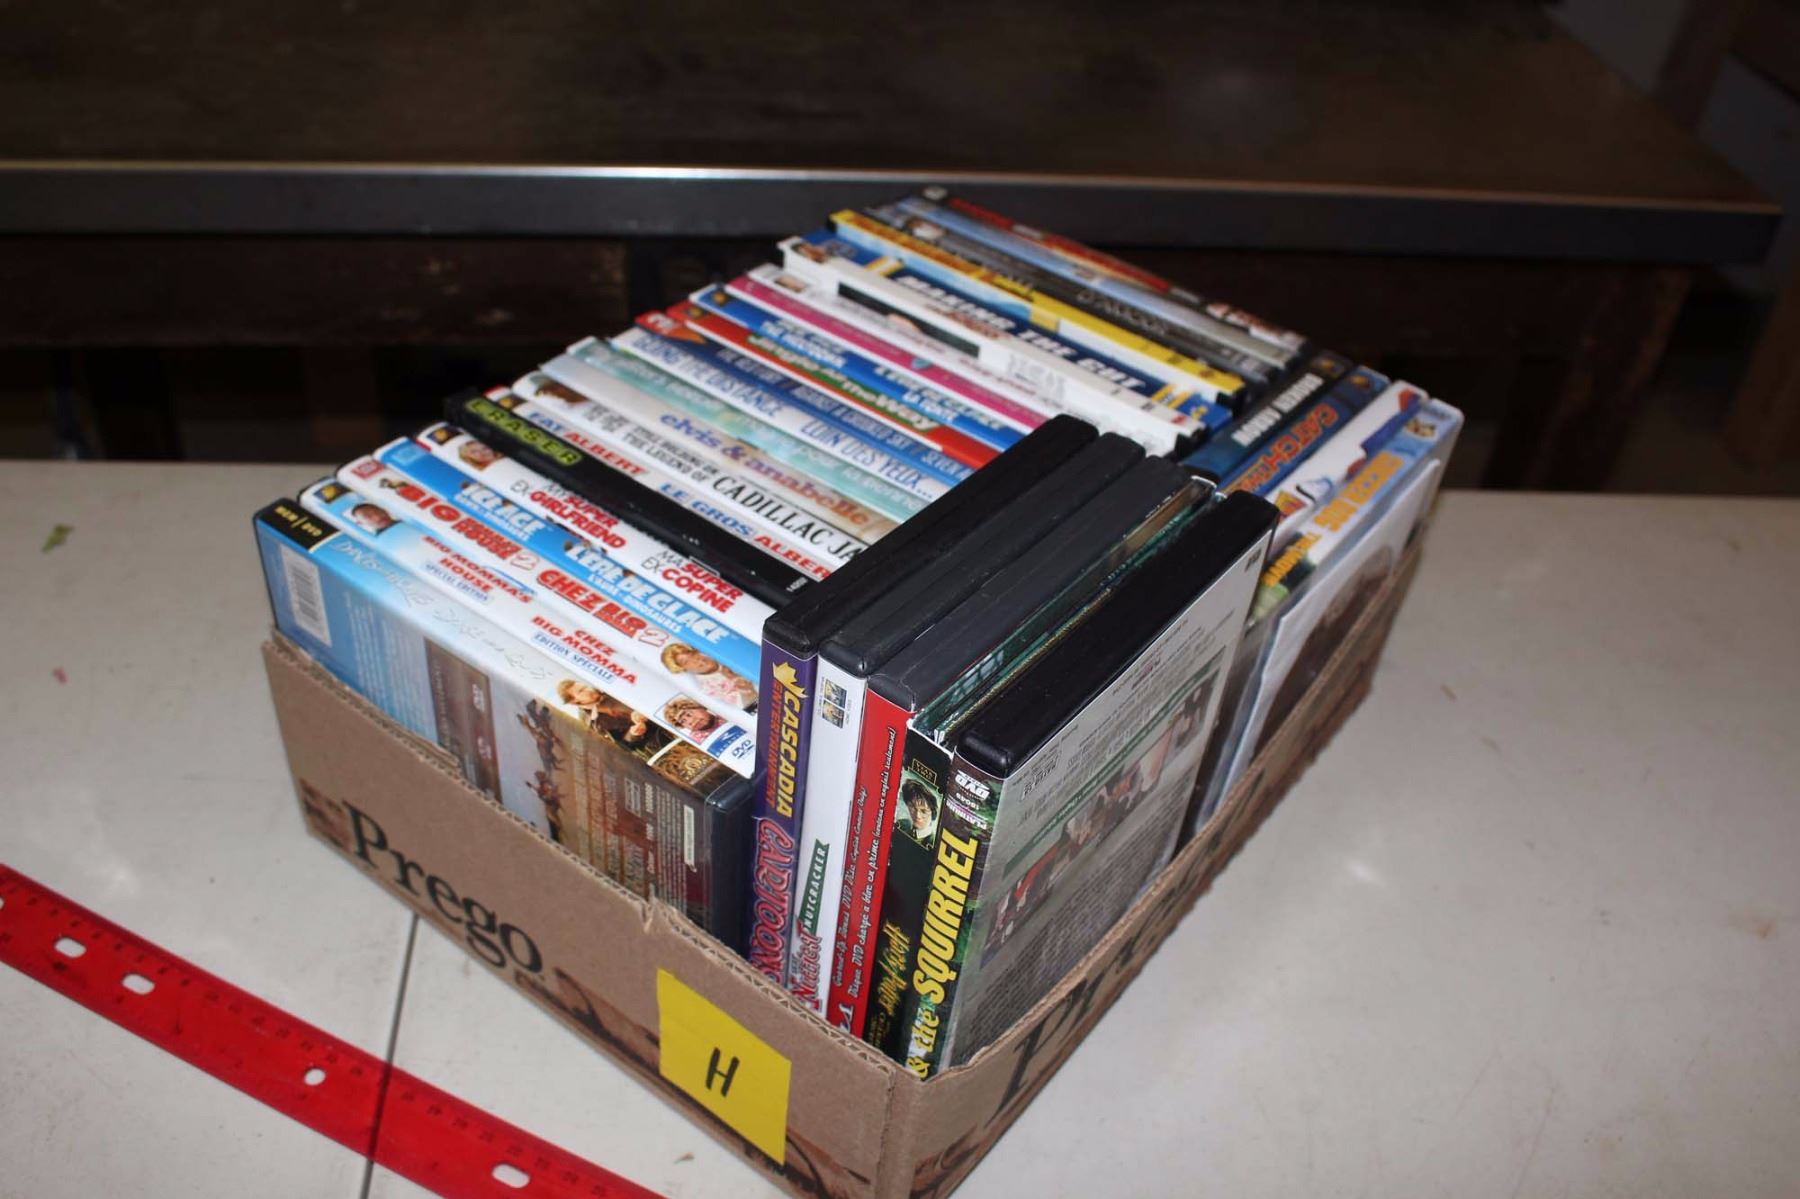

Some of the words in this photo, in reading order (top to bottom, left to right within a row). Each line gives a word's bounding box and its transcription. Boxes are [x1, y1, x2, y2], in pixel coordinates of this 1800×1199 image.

[896, 275, 1015, 329] MAKING
[1018, 327, 1077, 358] THE
[1076, 356, 1146, 391] CUT
[465, 397, 583, 466] ERASER
[869, 391, 939, 432] Way
[527, 410, 563, 433] FAT
[563, 431, 649, 477] ALBERT
[660, 410, 720, 450] elvis
[722, 442, 748, 461] &
[745, 457, 870, 527] anabelle
[395, 484, 462, 523] BIG
[460, 482, 503, 510] ICE
[498, 501, 547, 536] AGE
[564, 493, 620, 529] SUPER
[712, 475, 834, 546] CADILLAC
[826, 532, 868, 563] JA
[658, 481, 690, 502] LE
[691, 499, 751, 537] GROS
[753, 533, 832, 580] ALBER
[421, 534, 455, 553] BIG
[452, 552, 534, 604] MOMMA'S
[439, 557, 494, 594] HOUSE
[509, 549, 540, 572] 2
[654, 548, 683, 570] MA
[680, 560, 745, 601] SUPER
[536, 568, 599, 613] CHEZ
[600, 601, 648, 632] BIG
[638, 628, 670, 648] 2
[649, 588, 731, 645] GLACE
[531, 616, 565, 638] BIG
[562, 635, 638, 684] MOMMA
[574, 629, 617, 656] CHEZ
[766, 681, 784, 808] ENTERTAINMENT
[776, 689, 801, 818] CASCADIA
[955, 773, 990, 800] DVD
[866, 837, 881, 870] prime
[866, 871, 877, 883] en
[341, 799, 544, 973] Prego
[804, 847, 829, 929] NUTCRACKER
[862, 882, 874, 905] bloc
[912, 828, 978, 1006] SQUIRREL
[851, 943, 866, 967] DVD
[848, 969, 863, 998] Disque
[912, 1006, 941, 1053] the
[704, 1046, 741, 1099] H
[906, 1055, 930, 1078] &
